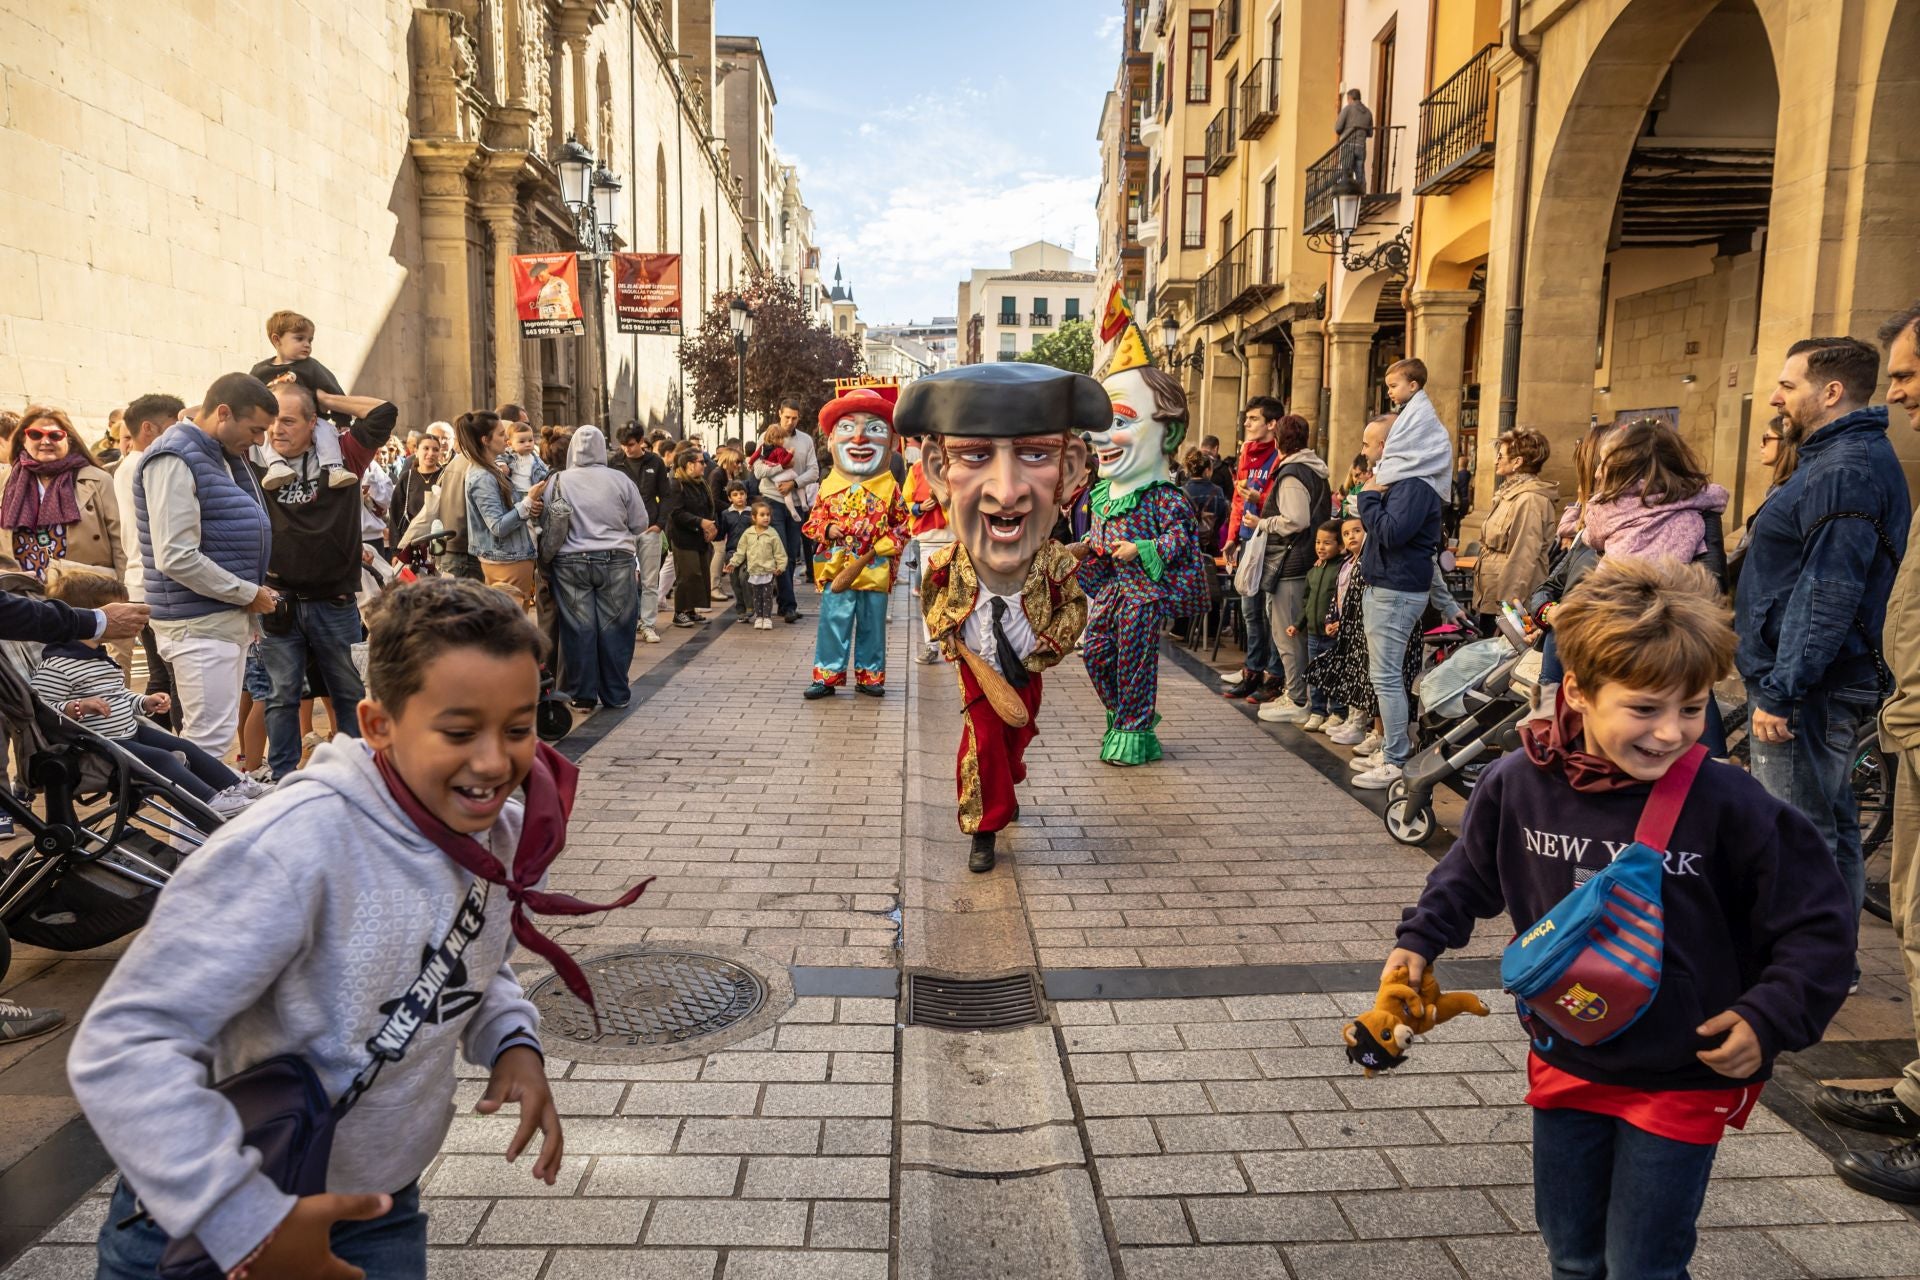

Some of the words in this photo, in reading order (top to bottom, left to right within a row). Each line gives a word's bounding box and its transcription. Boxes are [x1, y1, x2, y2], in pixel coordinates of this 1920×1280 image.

[1523, 827, 1592, 863] NEW
[1601, 840, 1703, 876] YRK
[1521, 919, 1555, 948] BARÇA
[409, 954, 451, 1010] NIKE
[375, 1002, 421, 1052] NIKE
